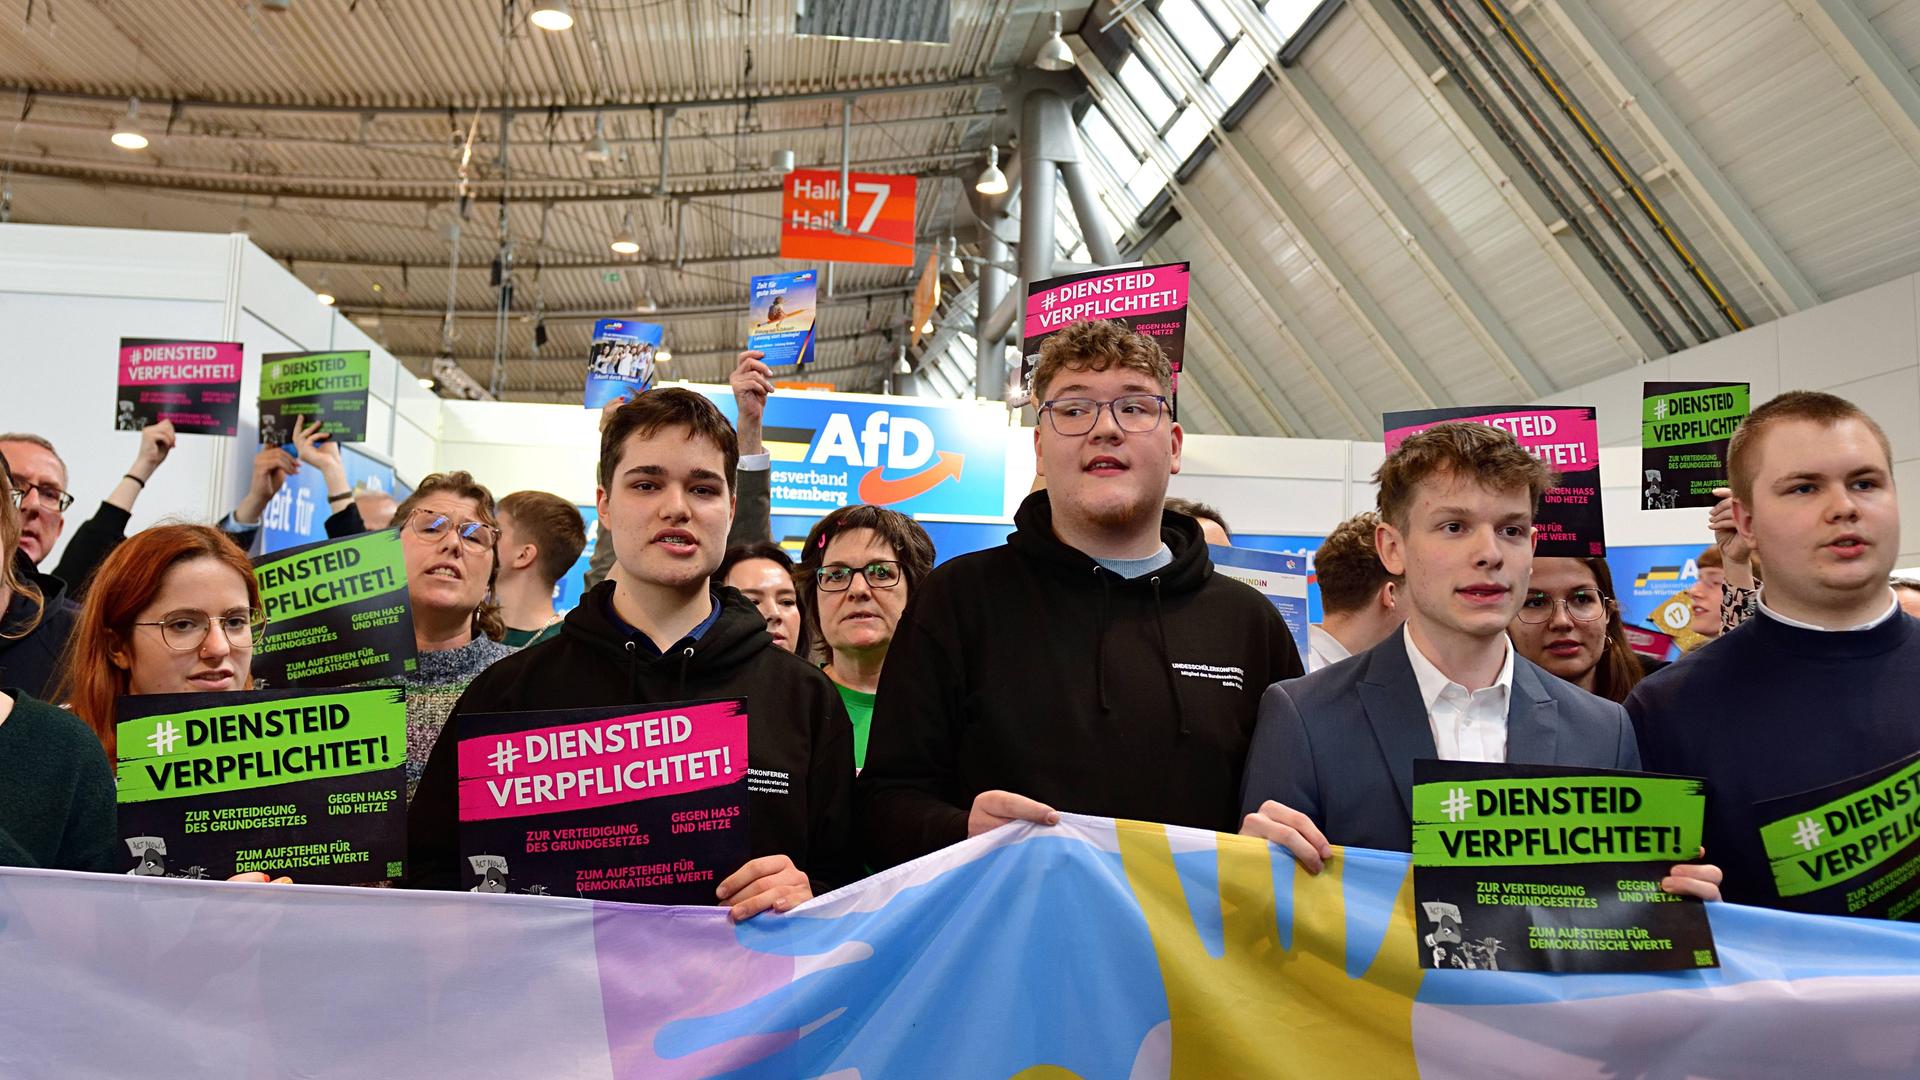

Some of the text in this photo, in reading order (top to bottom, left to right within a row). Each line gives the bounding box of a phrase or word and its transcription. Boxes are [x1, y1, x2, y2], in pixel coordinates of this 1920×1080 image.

[855, 183, 890, 233] 7
[1041, 273, 1155, 311] #DIENSTEID
[1039, 289, 1178, 328] VERPFLICHTET!
[129, 346, 217, 366] #DIENSTEID
[128, 364, 235, 381] VERPFLICHTET!
[271, 358, 346, 380] #DIENSTEID
[270, 374, 362, 396] VERPFLICHTET!
[1654, 392, 1734, 420] #DIENSTEID
[810, 410, 935, 470] AfD
[1679, 461, 1722, 469] GRUNDGESETZES
[1680, 454, 1717, 462] VERTEIDIGUNG
[771, 470, 847, 486] esverband
[770, 486, 847, 507] rttemberg
[1564, 496, 1588, 504] HETZE
[295, 487, 315, 536] für
[1547, 522, 1563, 532] FÜR
[258, 548, 361, 591] IENSTEID
[1680, 558, 1699, 580] A
[265, 566, 395, 617] PFLICHTET!
[352, 605, 405, 623] GEGEN HASS
[353, 615, 399, 631] UND HETZE
[1668, 607, 1684, 624] 17
[264, 632, 338, 653] GRUNDGESETZES
[266, 626, 328, 644] VERTEIDIGUNG
[286, 648, 374, 672] ZUM AUFSTEHEN FÜR
[287, 654, 390, 680] DEMOKRATISCHE WERTE
[146, 703, 350, 756] #DIENSTEID
[487, 715, 693, 775] #DIENSTEID
[145, 736, 389, 792] VERPFLICHTET!
[748, 768, 789, 779] ERKONFERENZ
[487, 746, 732, 808] VERPFLICHTET!
[748, 778, 788, 786] undessekretariats
[328, 791, 397, 804] GEGEN HASS
[1440, 787, 1642, 822] #DIENSTEID
[185, 805, 296, 822] ZUR VERTEIDIGUNG
[328, 802, 388, 815] UND HETZE
[671, 806, 740, 823] GEGEN HASS
[1791, 770, 1920, 851] #DIENST
[185, 815, 307, 834] DES GRUNDGESETZES
[526, 824, 639, 841] ZUR VERTEIDIGUNG
[671, 818, 731, 834] UND HETZE
[236, 841, 350, 861] ZUM AUFSTEHEN FÜR
[526, 834, 650, 853] DES GRUNDGESETZES
[1438, 826, 1681, 858] VERPFLICHTET!
[236, 852, 369, 873] DEMOKRATISCHE WERTE
[576, 860, 694, 881] ZUM AUFSTEHEN FÜR
[576, 870, 713, 892] DEMOKRATISCHE WERTE
[1477, 882, 1586, 896] ZUR VERTEIDIGUNG
[1617, 880, 1655, 891] GEGEN
[1477, 894, 1598, 909] DES GRUNDGESETZES
[1618, 892, 1643, 902] UND
[1529, 927, 1649, 940] ZUM AUFSTEHEN FÜR
[1529, 938, 1672, 951] DEMOKRATISCHE WERTE
